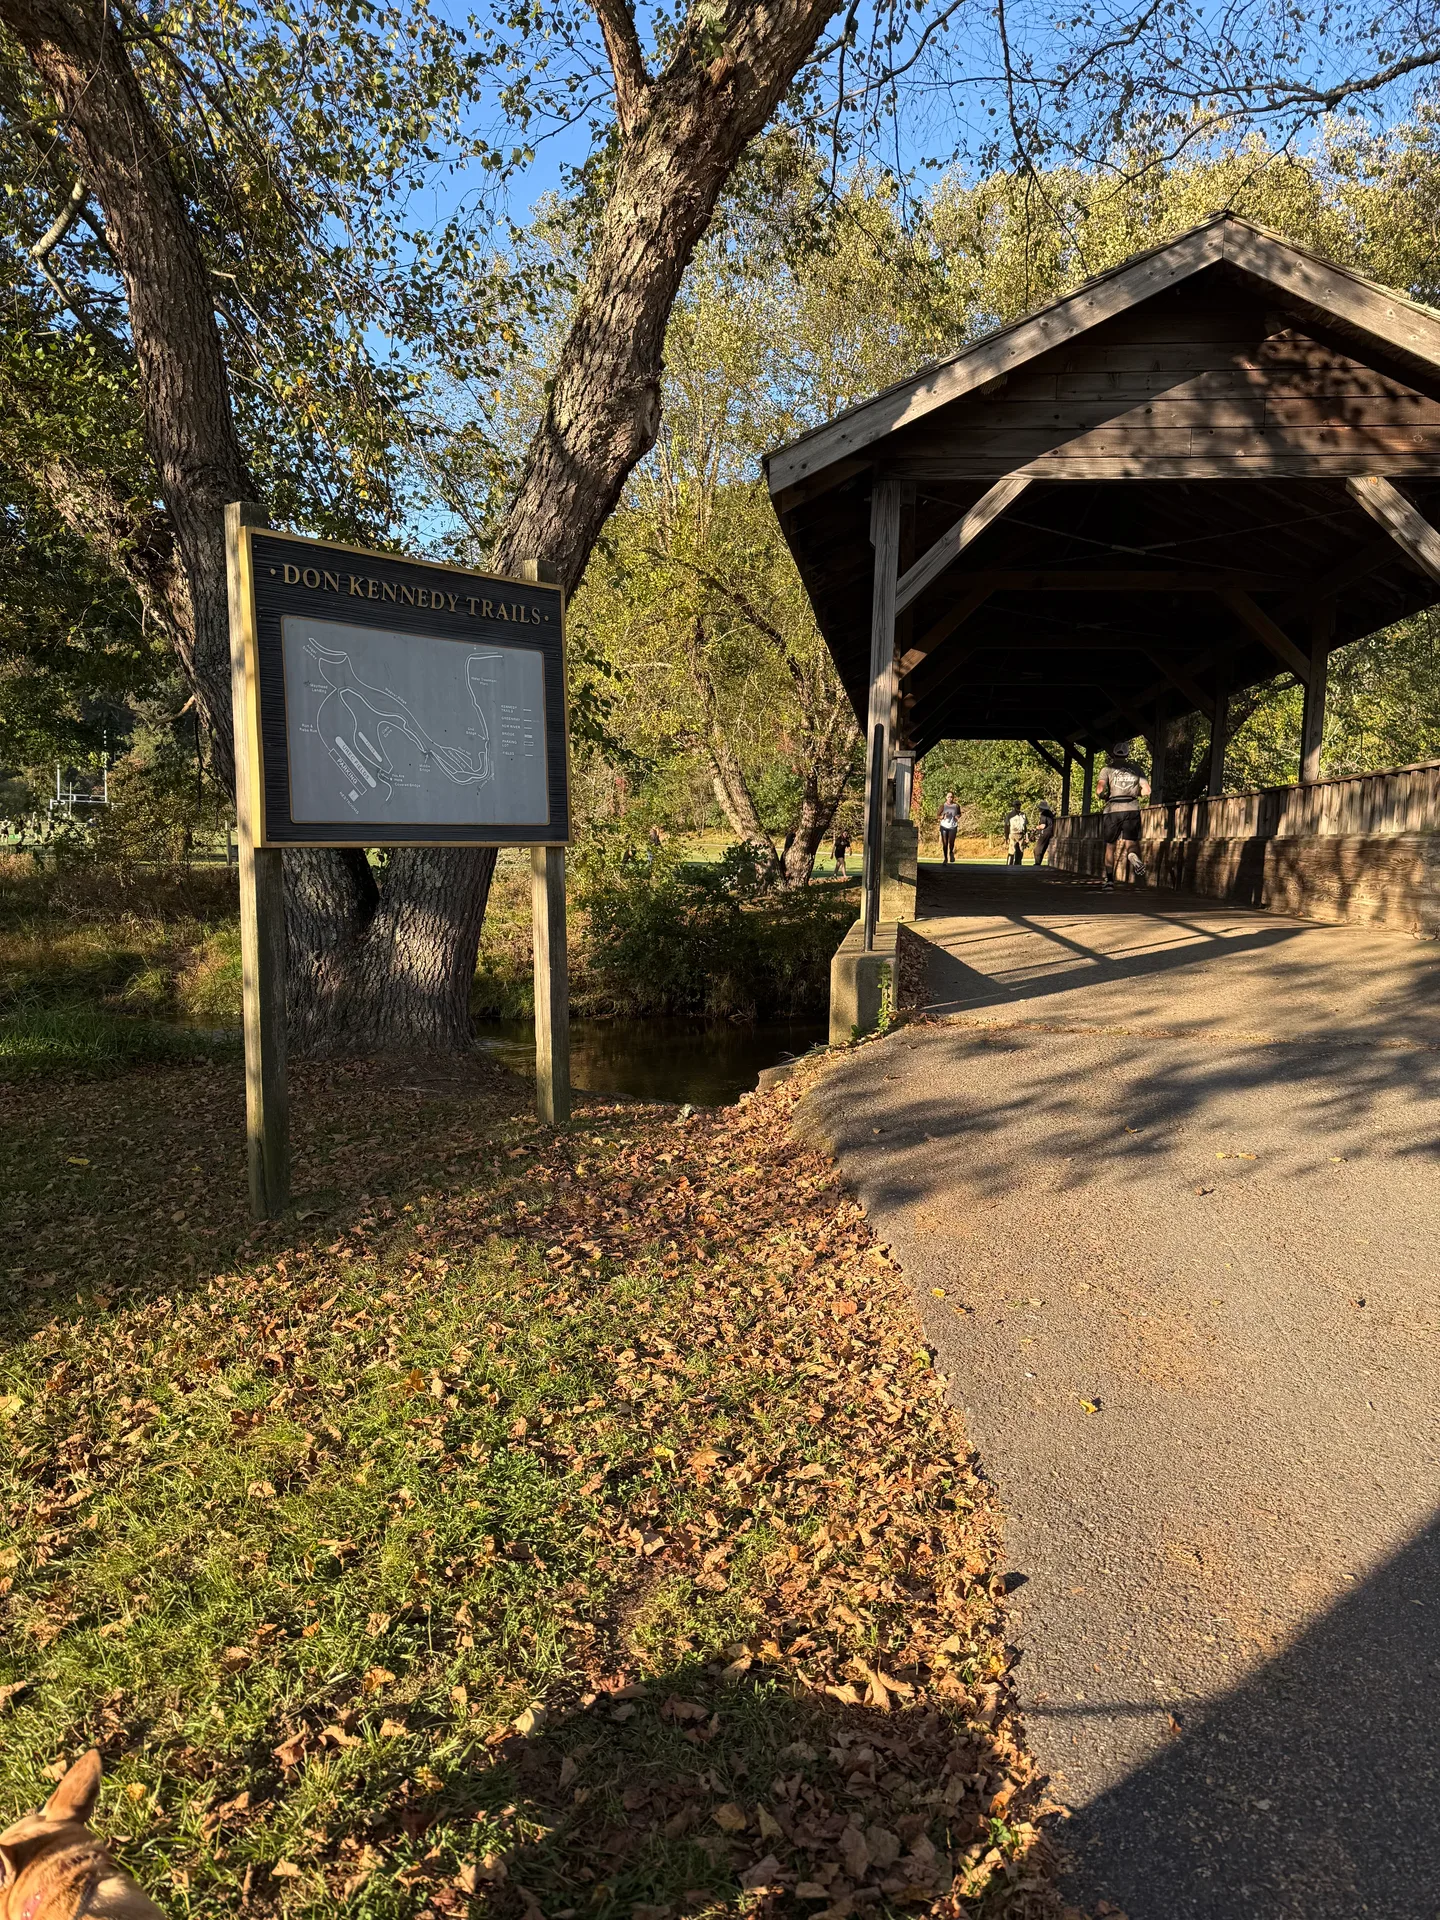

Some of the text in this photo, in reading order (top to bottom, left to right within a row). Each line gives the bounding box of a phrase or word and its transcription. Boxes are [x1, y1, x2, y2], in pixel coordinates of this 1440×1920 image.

[283, 564, 541, 625] DON KENNEDY TRAILS
[337, 758, 358, 784] PARKING
[342, 744, 370, 780] UREC FIELDS
